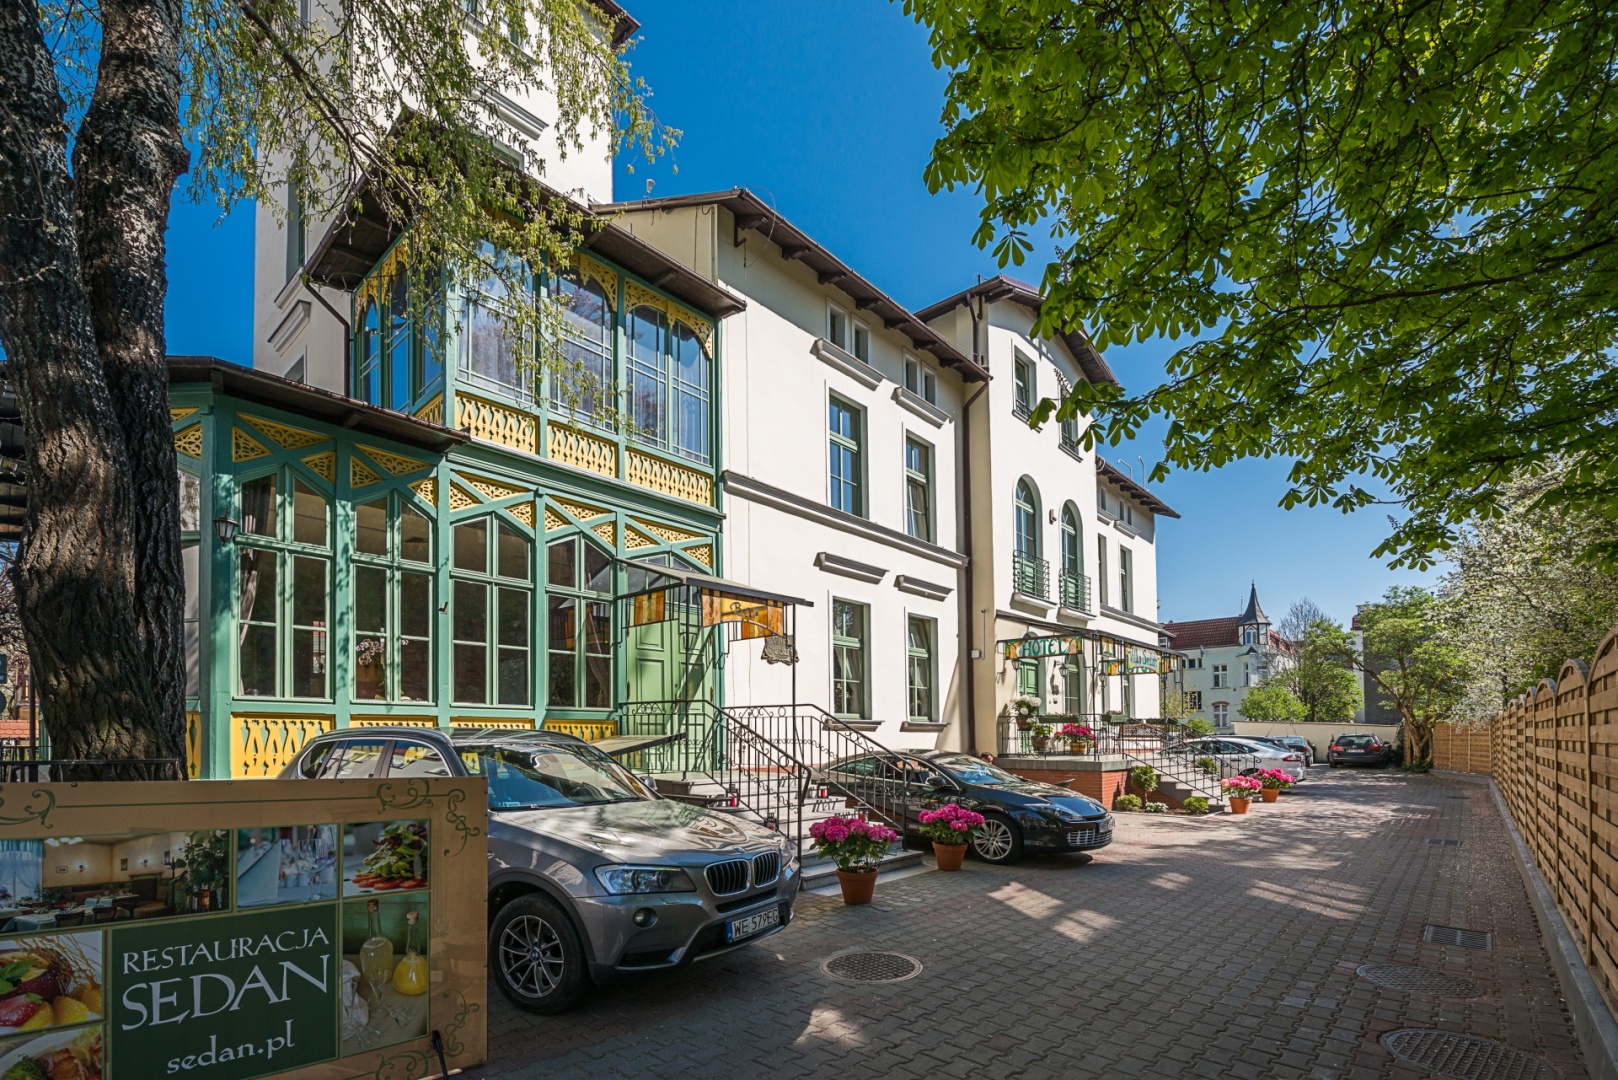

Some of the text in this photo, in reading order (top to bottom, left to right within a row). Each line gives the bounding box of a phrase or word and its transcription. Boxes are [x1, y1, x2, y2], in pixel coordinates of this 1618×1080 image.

[1021, 638, 1067, 657] HOTEL
[733, 909, 779, 937] WE 579EG
[122, 926, 330, 975] RESTAURACJA
[121, 954, 330, 1031] SEDAN
[166, 1019, 296, 1074] sedan.pl
